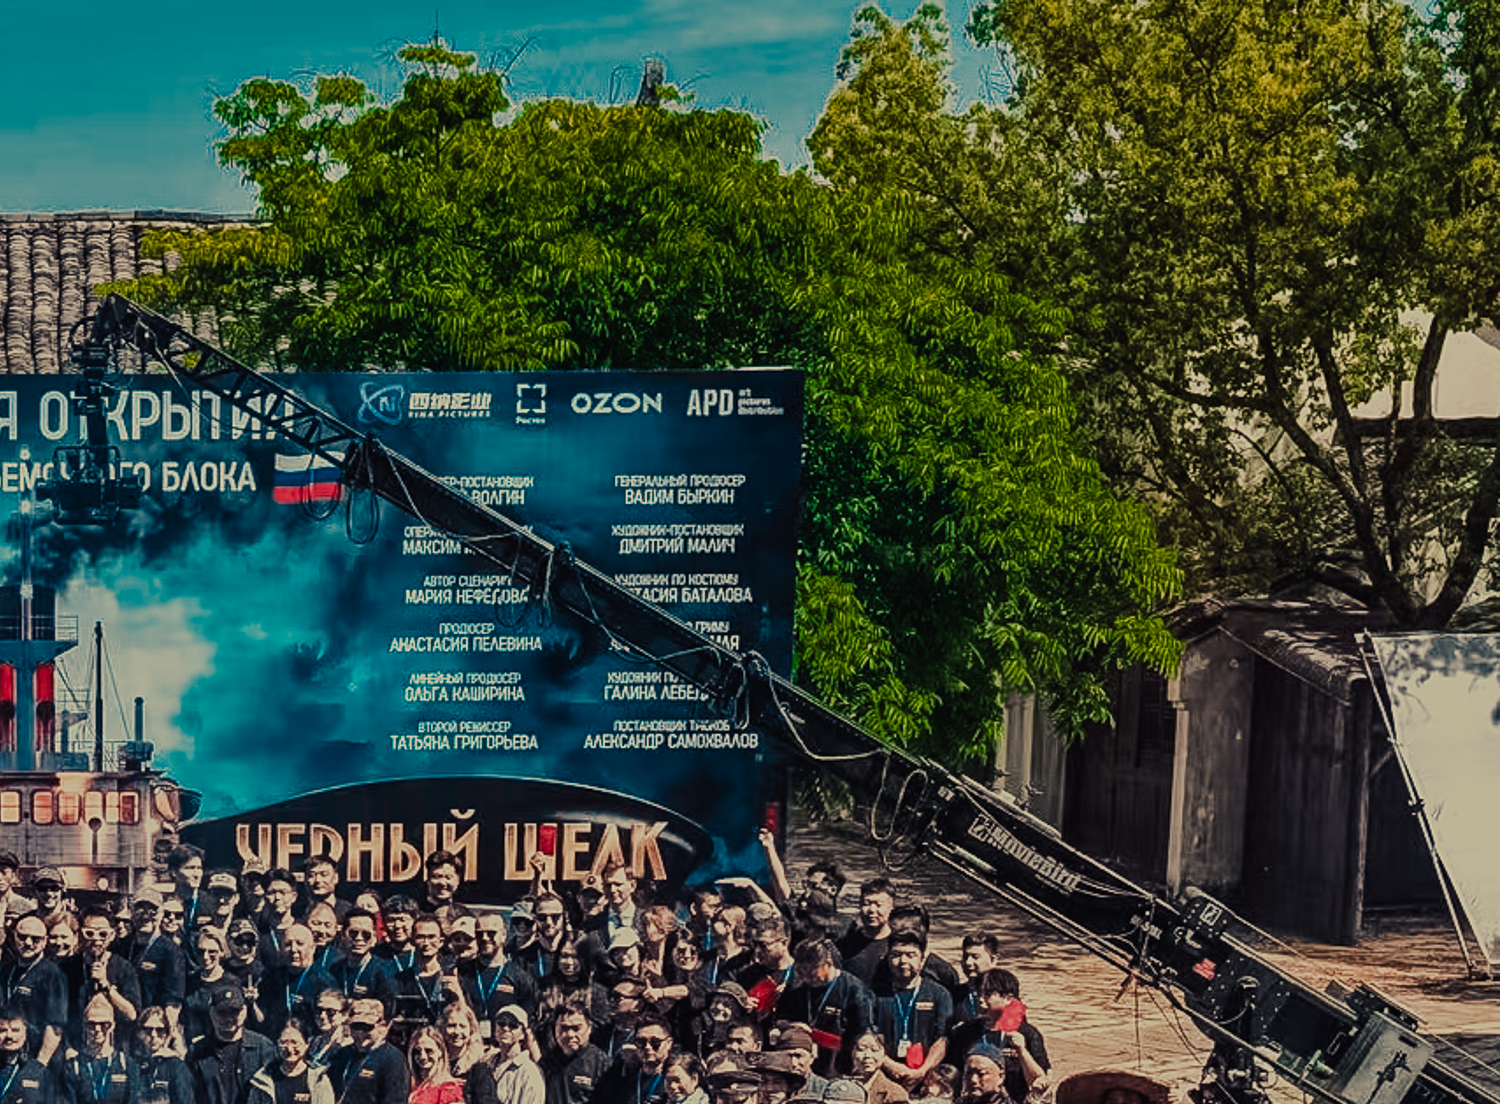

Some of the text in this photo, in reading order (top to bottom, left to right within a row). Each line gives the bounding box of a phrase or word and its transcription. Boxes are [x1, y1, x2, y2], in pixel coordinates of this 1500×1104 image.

[570, 392, 662, 414] OZON
[686, 388, 734, 417] APD
[161, 461, 257, 492] БЛОКА
[614, 474, 746, 487] ГЕНЕРАЛЬНЫЙ ПРОДЮСЕР
[625, 488, 735, 505] ВАДИМ БЫРКИН
[402, 539, 462, 555] МАКСИМ
[618, 537, 684, 554] ДМИТРИЙ
[423, 575, 456, 587] АВТОР
[671, 573, 686, 586] ПО
[688, 573, 739, 586] КОСТЮМУ
[405, 588, 453, 604] МАРИЯ
[681, 587, 753, 603] БАТАЛОВА
[439, 623, 495, 634] ПРОДЮСЕР
[390, 636, 543, 652] АНАСТАСИЯ ПЕЛЕВИНА
[465, 672, 522, 685] ПРОДЮСЕР
[404, 686, 526, 701] ОЛЬГА КАШИРИНА
[604, 685, 657, 700] ГАЛИНА
[417, 720, 512, 733] ВТОРОЙ РЕЖИССЕР
[390, 734, 539, 750] ТАТЬЯНА ГРИГОРЬЕВА
[583, 734, 759, 750] АЛЕКСАНДР САМОХВАЛОВ
[235, 808, 480, 882] ЧЕРНЫЙ
